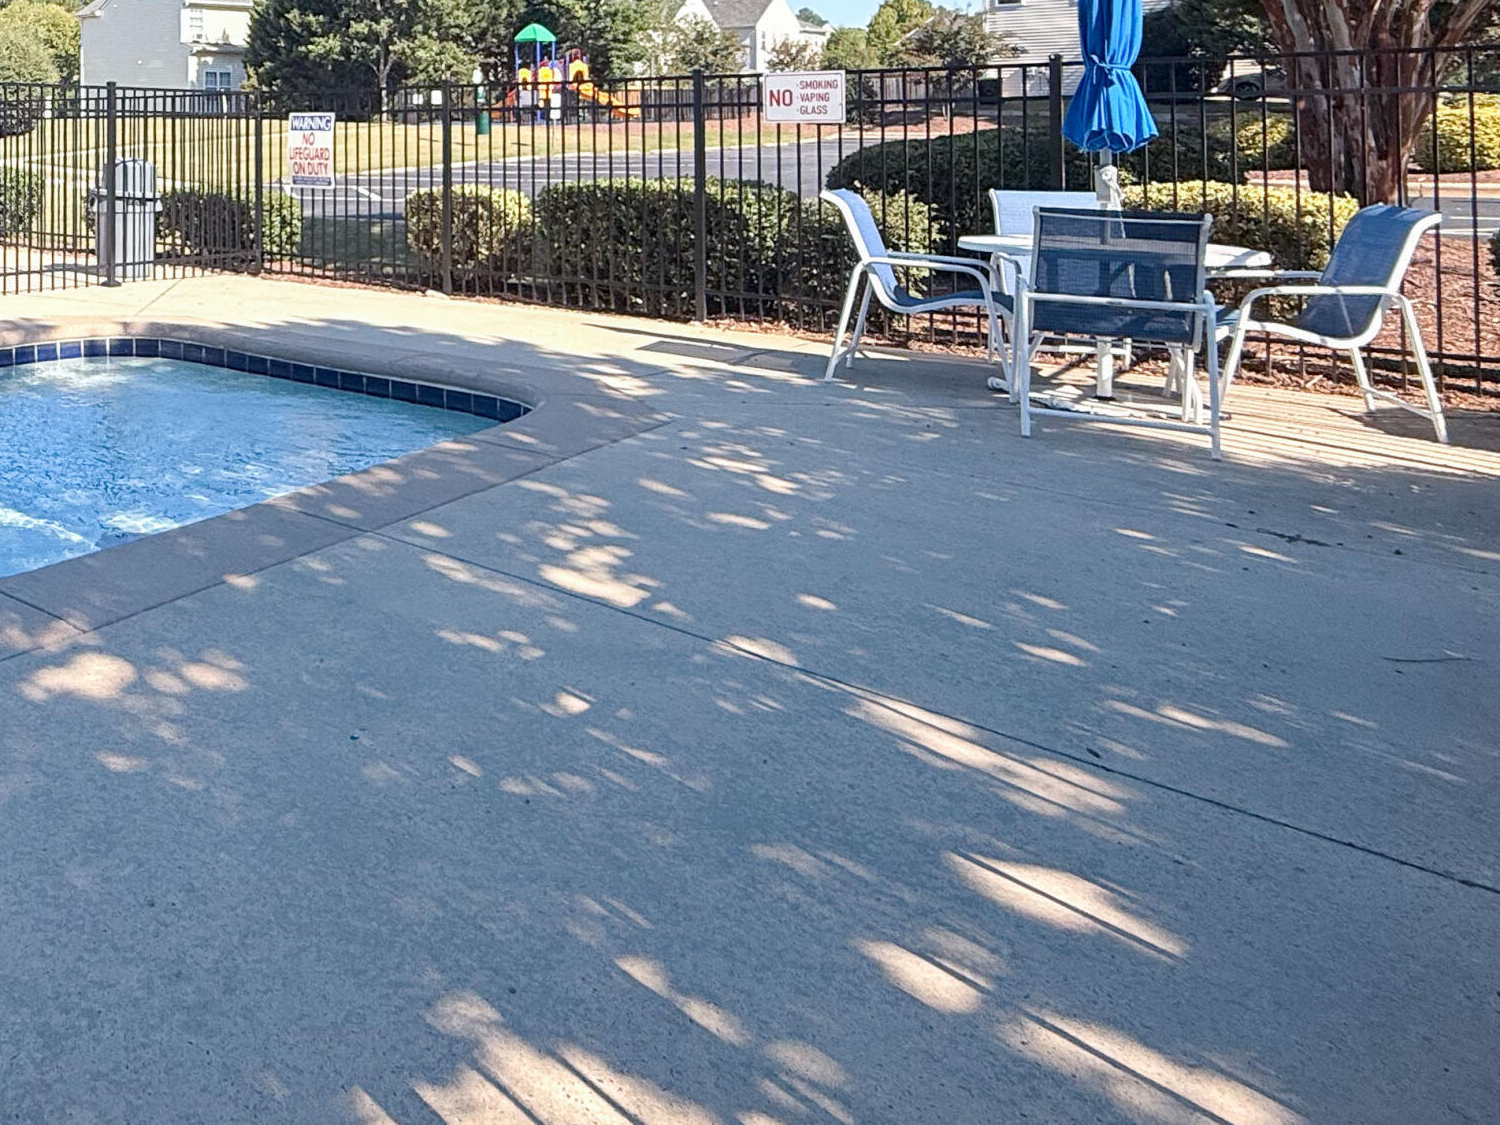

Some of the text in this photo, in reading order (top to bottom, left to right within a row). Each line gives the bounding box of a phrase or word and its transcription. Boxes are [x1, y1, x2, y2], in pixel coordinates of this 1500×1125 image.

[799, 79, 838, 90] SMOKING
[769, 89, 793, 107] NO
[799, 92, 830, 103] VAPING
[799, 105, 828, 115] GLASS
[292, 116, 331, 131] WARNING
[303, 132, 316, 146] NO
[289, 146, 330, 161] LIFEGUARD
[292, 161, 328, 176] ON DUTY
